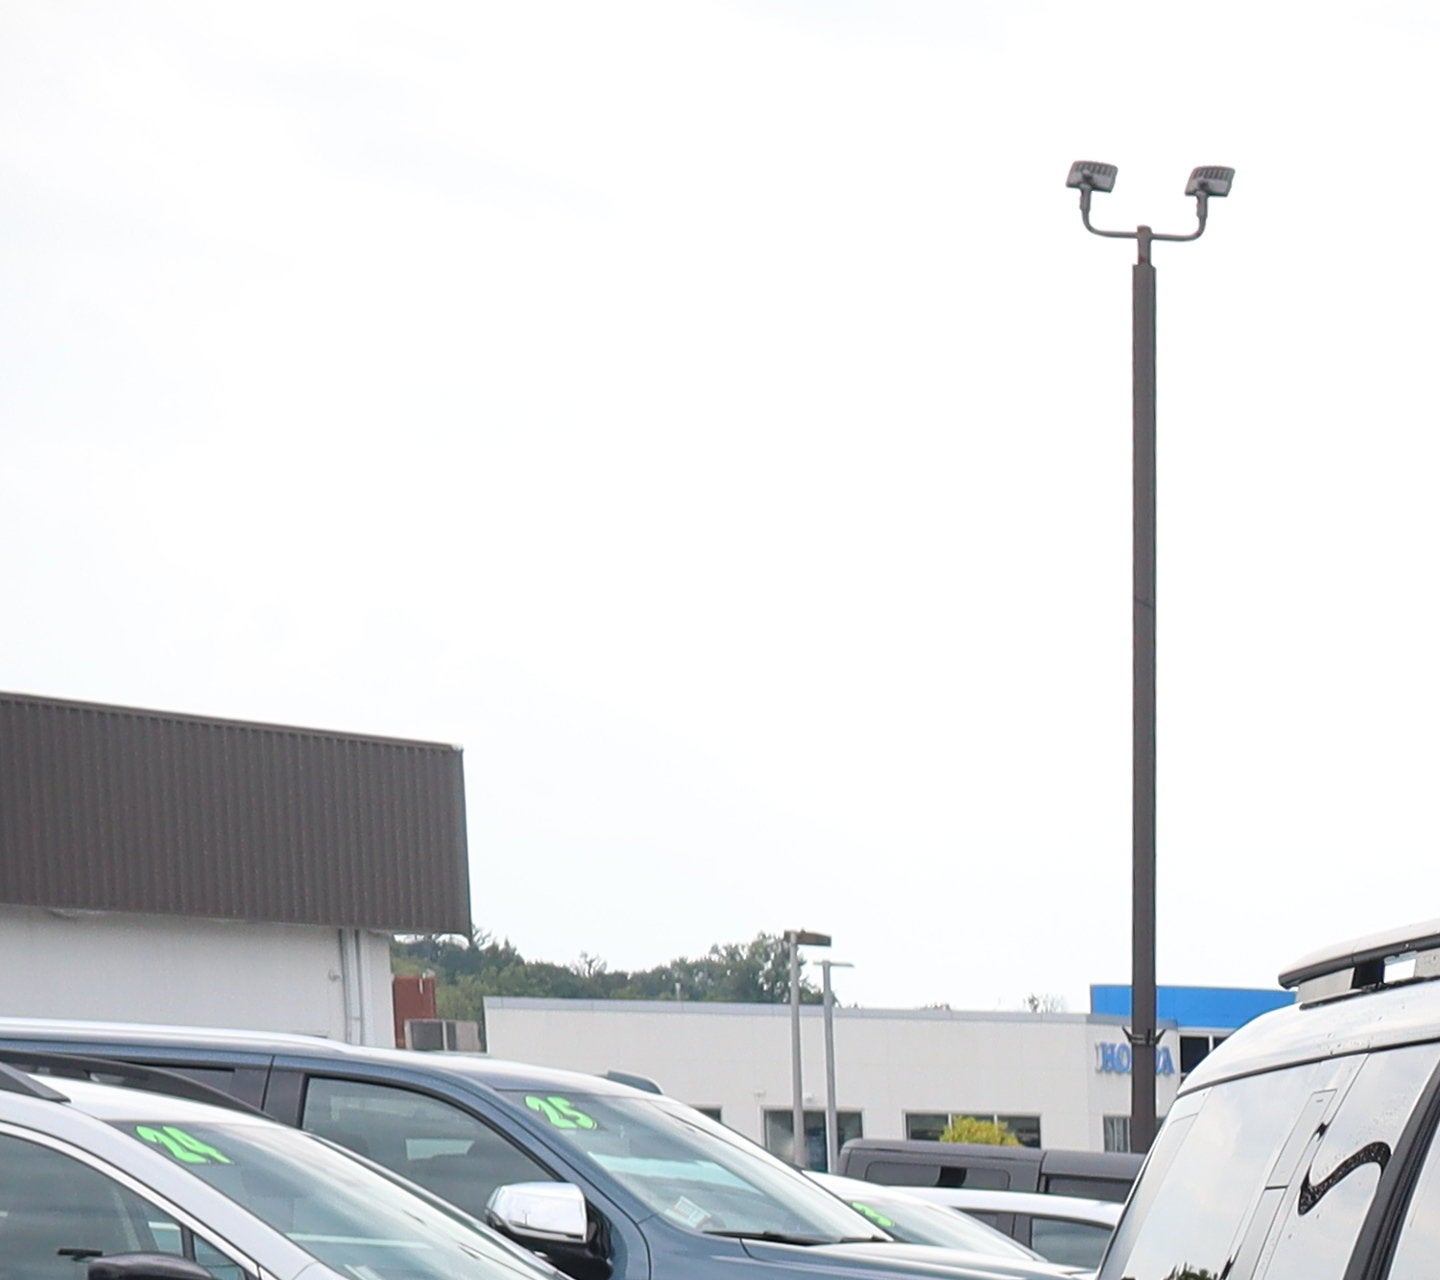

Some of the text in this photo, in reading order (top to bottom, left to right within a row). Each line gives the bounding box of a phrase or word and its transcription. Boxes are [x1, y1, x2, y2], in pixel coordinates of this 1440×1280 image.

[1100, 1042, 1175, 1074] HOA
[525, 1095, 598, 1129] 25
[136, 1125, 233, 1164] 24
